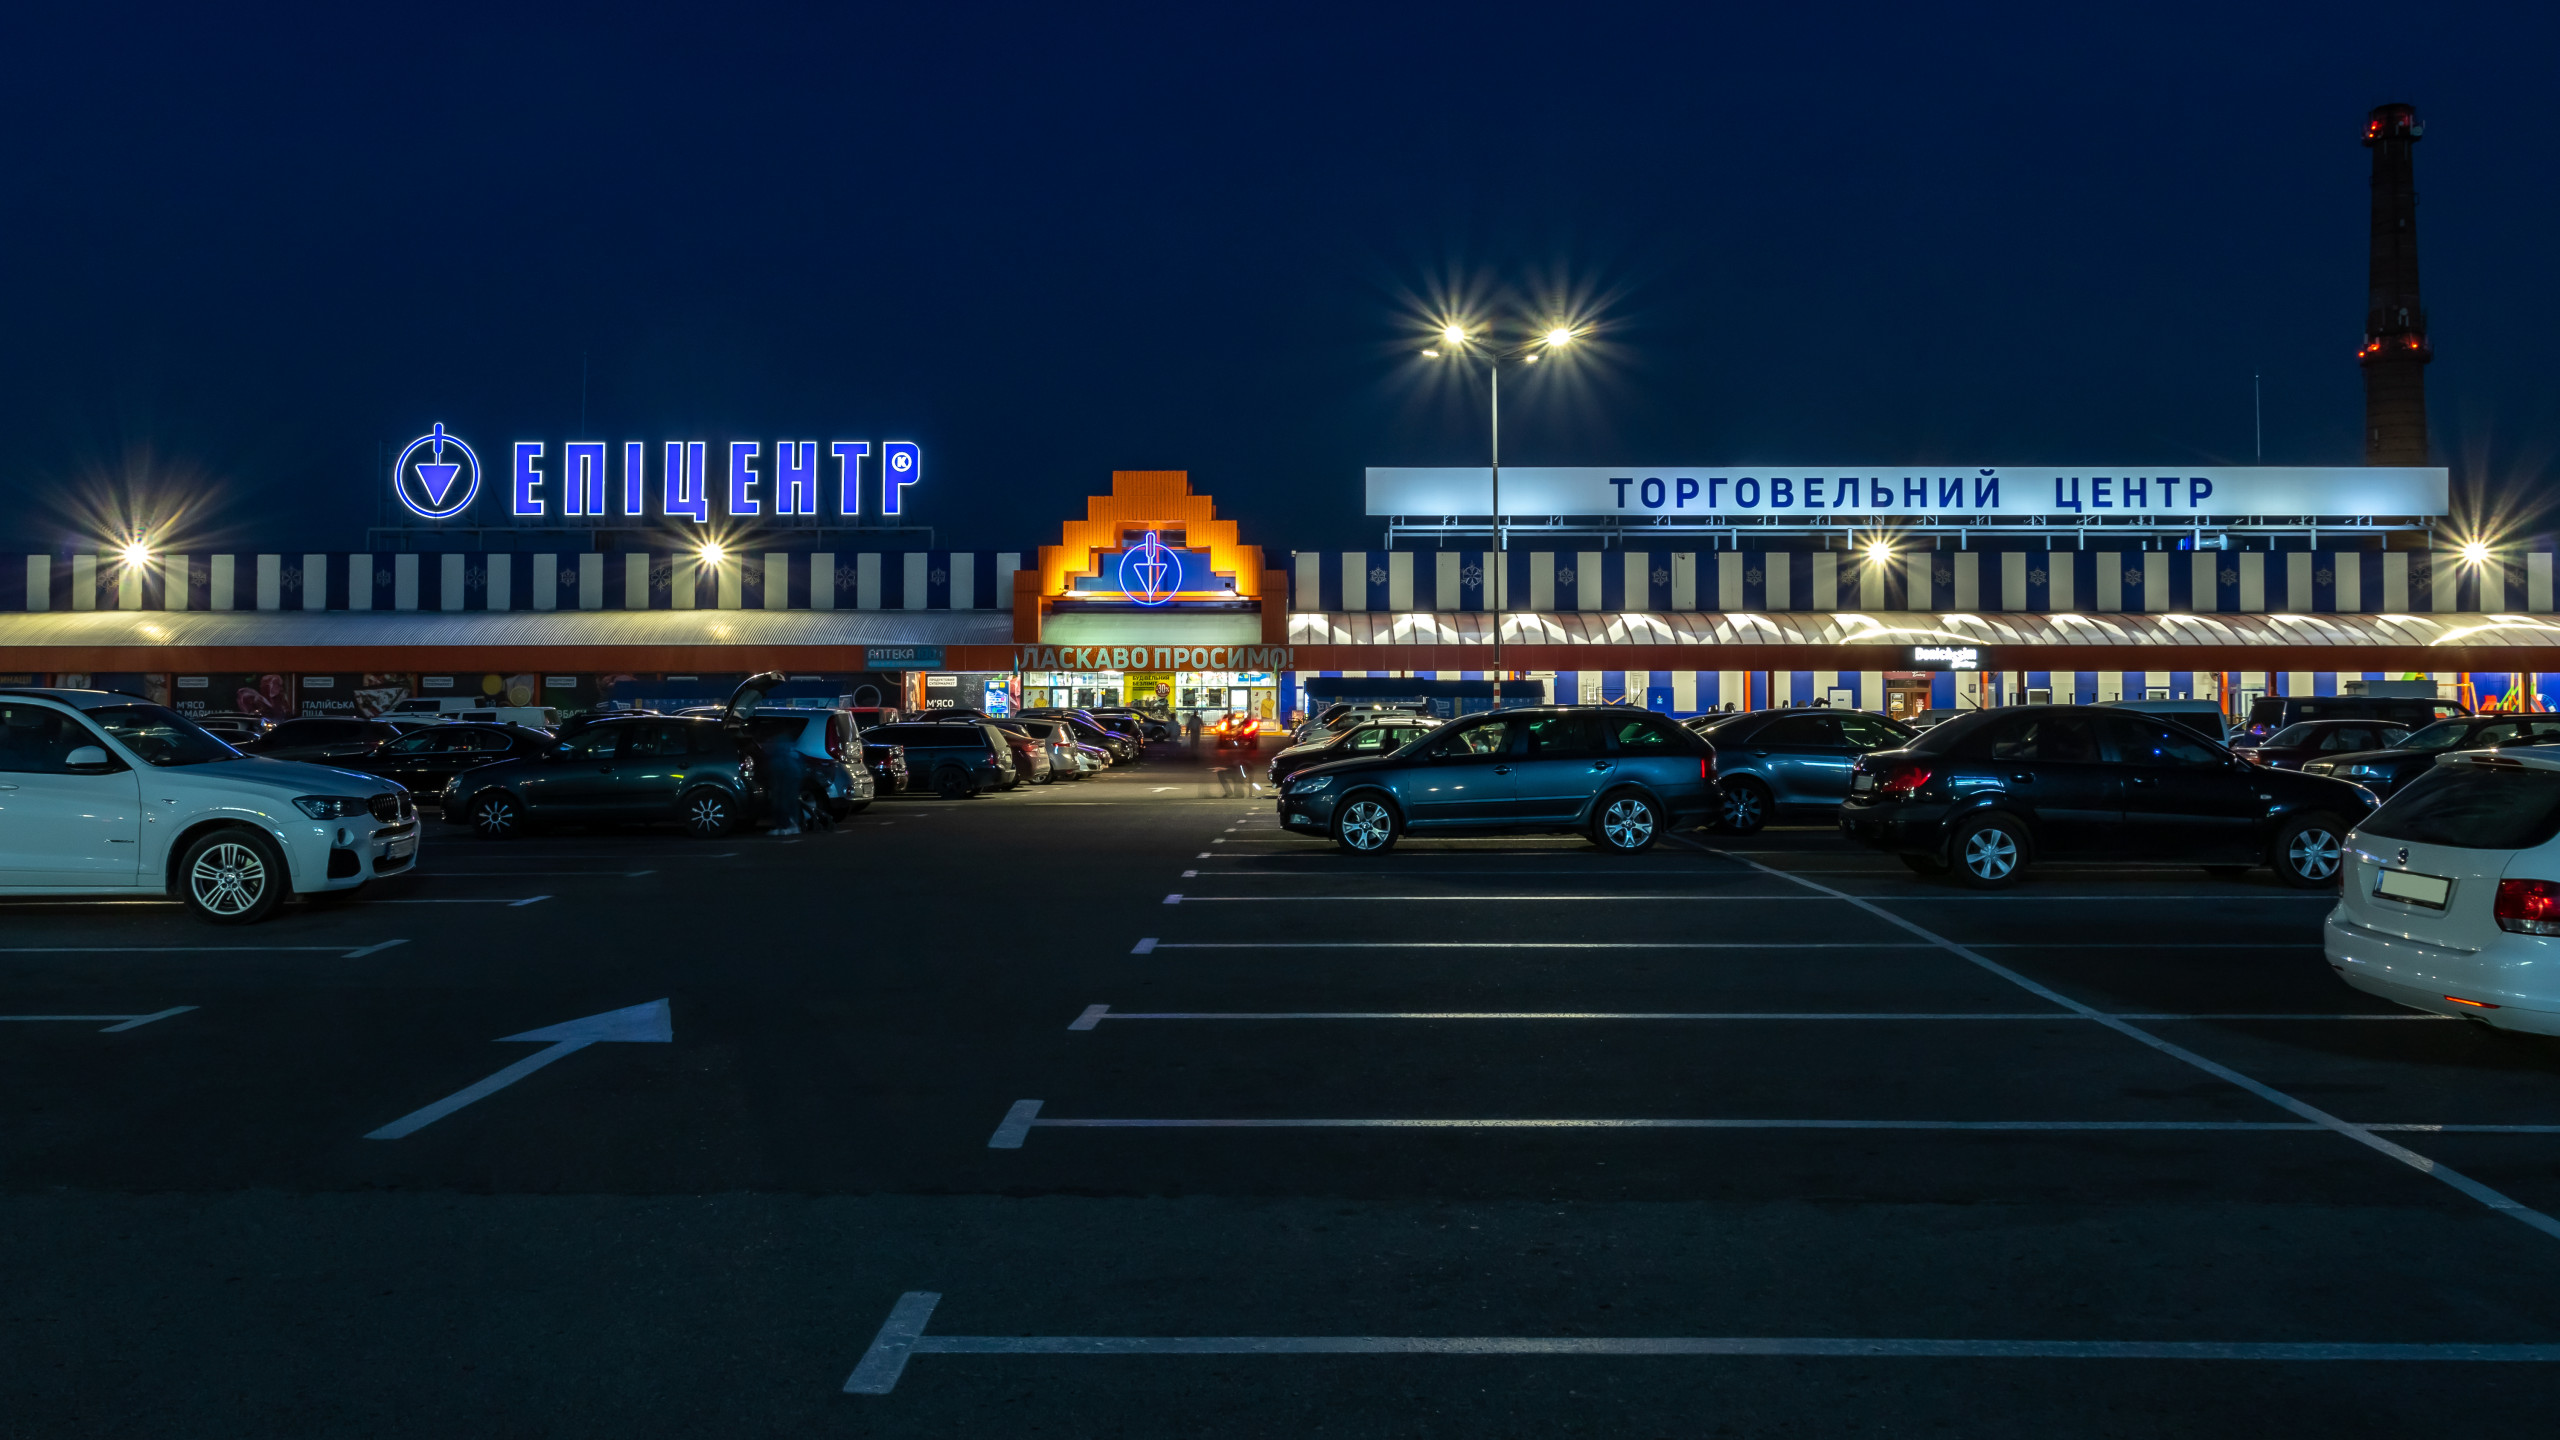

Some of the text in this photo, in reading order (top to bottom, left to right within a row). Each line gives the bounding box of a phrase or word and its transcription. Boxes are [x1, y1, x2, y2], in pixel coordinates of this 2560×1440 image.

[513, 441, 920, 523] ЕПІЦЕНТР
[1609, 469, 2213, 513] ТОРГОВЕЛЬНИЙ ЦЕНТР
[868, 649, 914, 659] АПТЕКА
[1020, 647, 1294, 669] ЛАСКАВО ПРОСИМО!
[302, 699, 355, 710] ІТАЛІЙСЬКА
[926, 699, 954, 708] М'ЯСО
